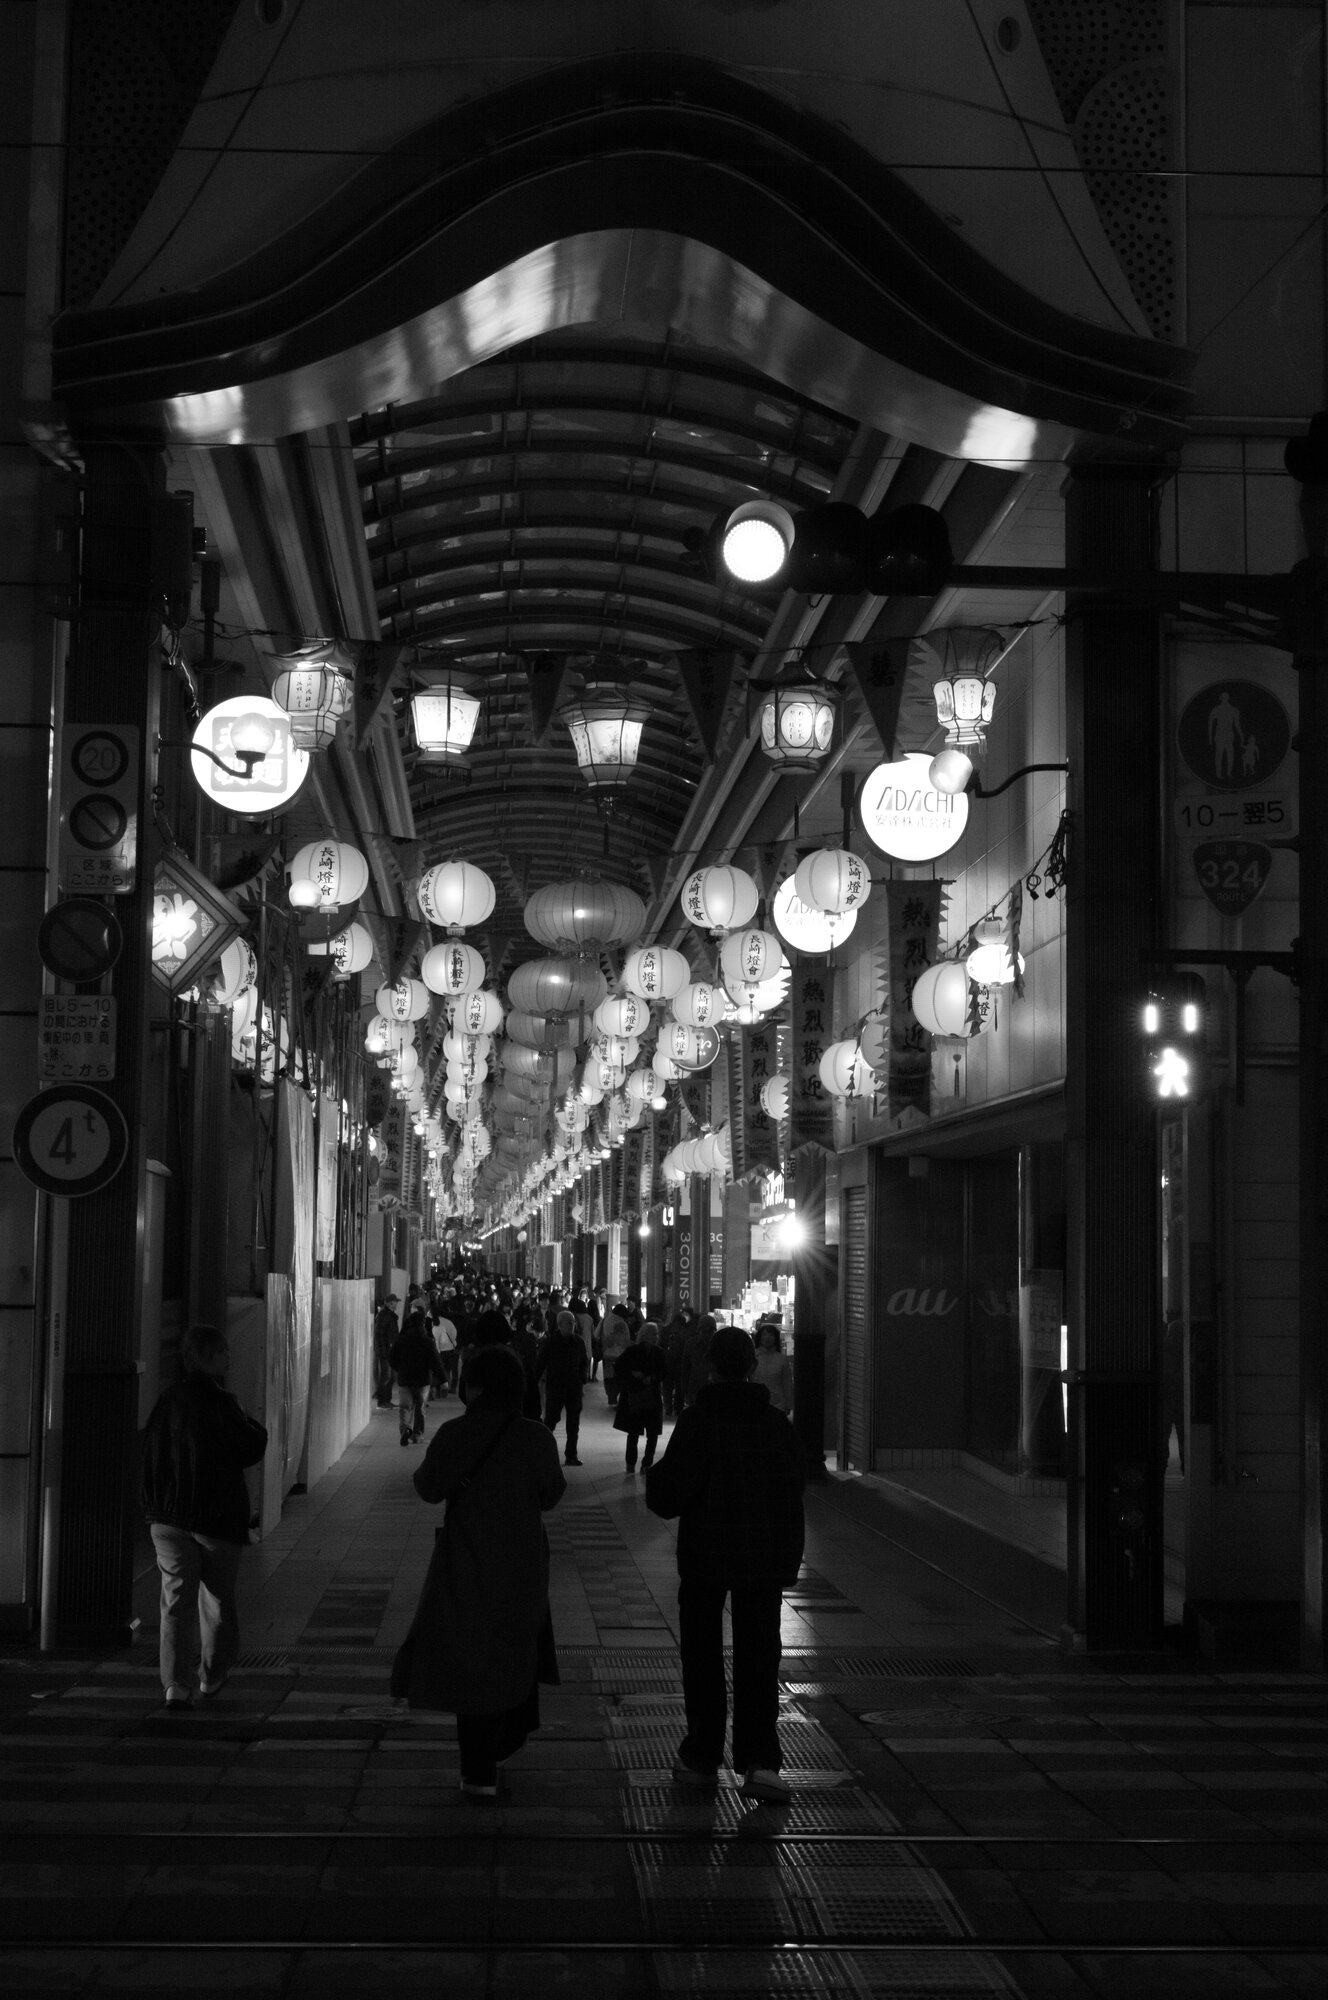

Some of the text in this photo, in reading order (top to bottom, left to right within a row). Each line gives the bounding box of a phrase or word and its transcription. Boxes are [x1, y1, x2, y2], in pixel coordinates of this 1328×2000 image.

[84, 747, 115, 771] 20
[876, 786, 954, 813] ADACHI
[83, 859, 112, 871] 区域
[1201, 860, 1262, 888] 324
[71, 875, 124, 886] ここから
[44, 1064, 109, 1077] ここから
[887, 1288, 959, 1316] au
